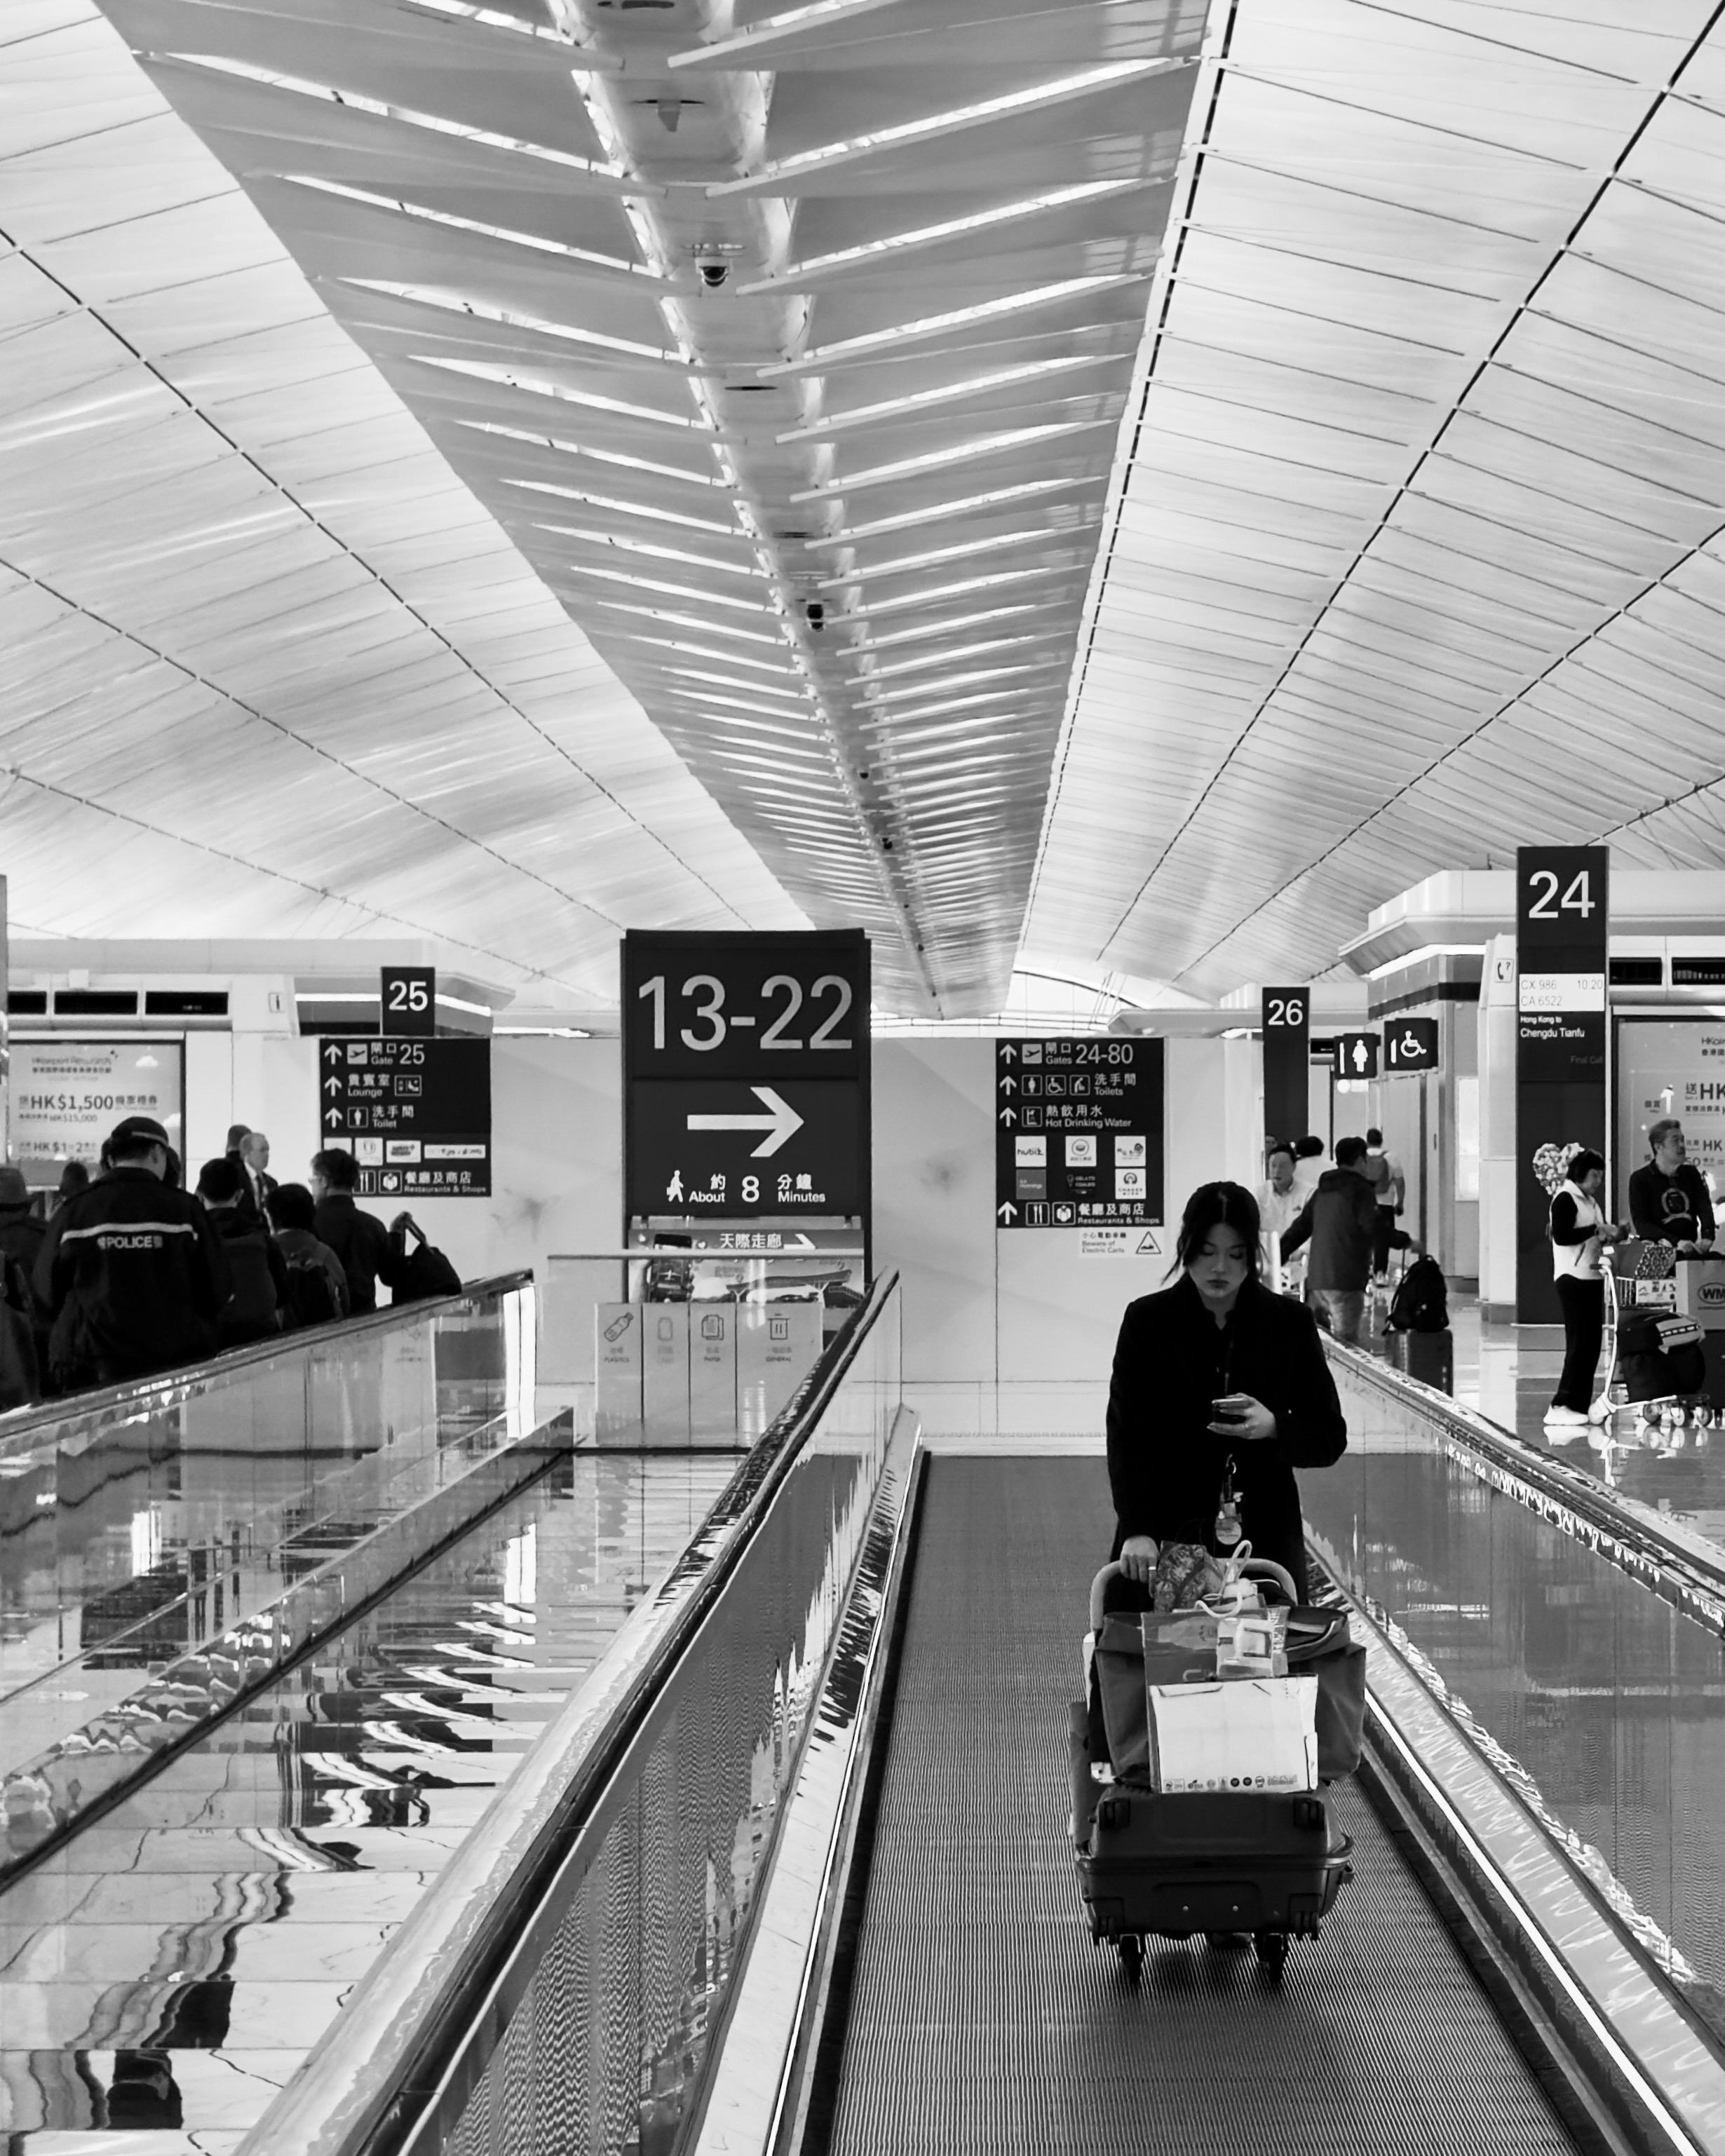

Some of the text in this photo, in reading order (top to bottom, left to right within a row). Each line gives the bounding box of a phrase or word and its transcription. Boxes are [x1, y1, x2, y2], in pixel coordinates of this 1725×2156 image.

[1529, 870, 1595, 918] 24
[1520, 979, 1536, 990] CX
[1538, 979, 1557, 990] 986
[388, 980, 428, 1012] 25
[1520, 996, 1563, 1006] CA 6522
[639, 975, 853, 1051] 13-22
[1268, 999, 1303, 1026] 26
[1520, 1015, 1537, 1024] Hong
[1538, 1015, 1554, 1024] Kong
[1520, 1027, 1585, 1040] Chengdu Tianfu
[370, 1055, 393, 1065] Gate
[399, 1044, 425, 1064] 25
[1046, 1055, 1072, 1064] Gates
[1076, 1043, 1133, 1064] 24-80
[1094, 1073, 1136, 1086] 洗手間
[348, 1087, 383, 1098] Lounge
[1094, 1087, 1123, 1096] Toilets
[31, 1094, 114, 1113] HK$1,500
[372, 1105, 414, 1118] 洗手間
[1046, 1104, 1102, 1118] 熱飲用水
[372, 1119, 397, 1128] Toilet
[1046, 1118, 1132, 1129] Hot Drinking Water
[710, 1174, 726, 1190] 約
[741, 1175, 759, 1202] 8
[777, 1174, 813, 1190] 分鐘
[689, 1191, 826, 1203] About Minutes
[1078, 1202, 1144, 1216] 餐廳及商店
[107, 1236, 152, 1249] POLICE
[719, 1233, 782, 1249] 天際走廊
